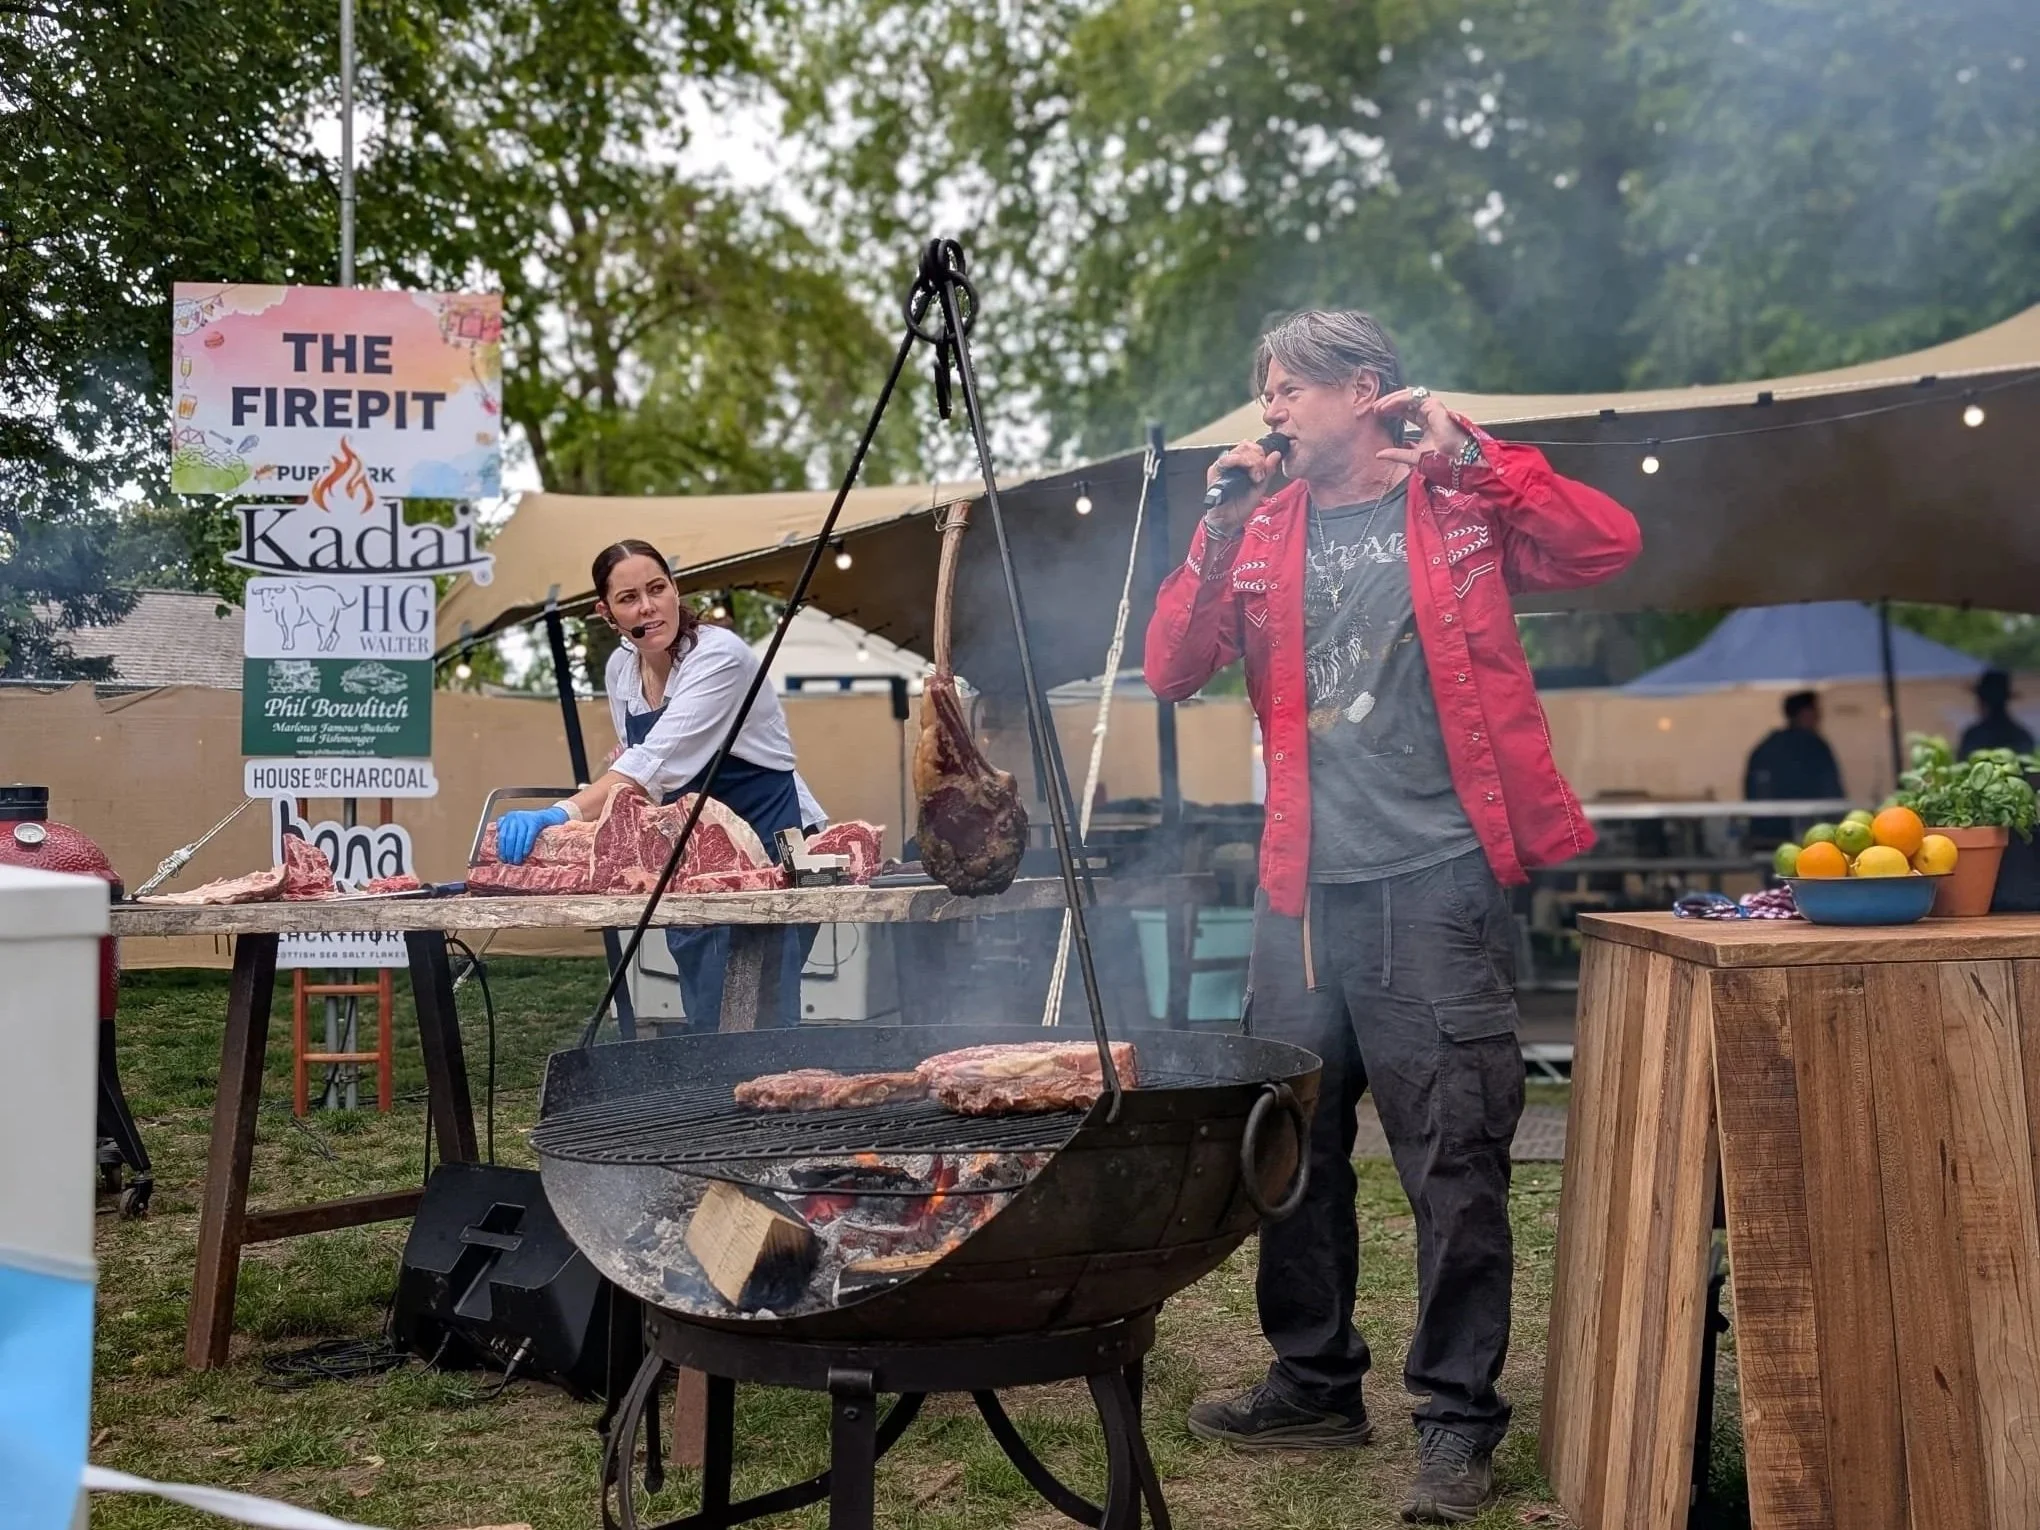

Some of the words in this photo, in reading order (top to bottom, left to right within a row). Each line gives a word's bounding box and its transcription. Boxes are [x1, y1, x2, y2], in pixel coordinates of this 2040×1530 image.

[282, 332, 393, 375] THE
[231, 386, 446, 431] FIREPIT
[235, 503, 474, 570] Kadai
[360, 585, 429, 634] HG
[360, 636, 429, 653] WALTER
[264, 695, 311, 718] Phil
[311, 695, 409, 719] Bowditch
[272, 722, 318, 733] Marlows
[320, 723, 358, 734] Famous
[361, 723, 401, 733] Butcher
[296, 733, 316, 744] and
[317, 733, 376, 747] Fishmonger
[254, 767, 311, 789] HOUSE
[314, 768, 328, 781] OF
[330, 767, 429, 789] CHARCOAL
[319, 951, 338, 959] SEA
[342, 951, 366, 959] SALT
